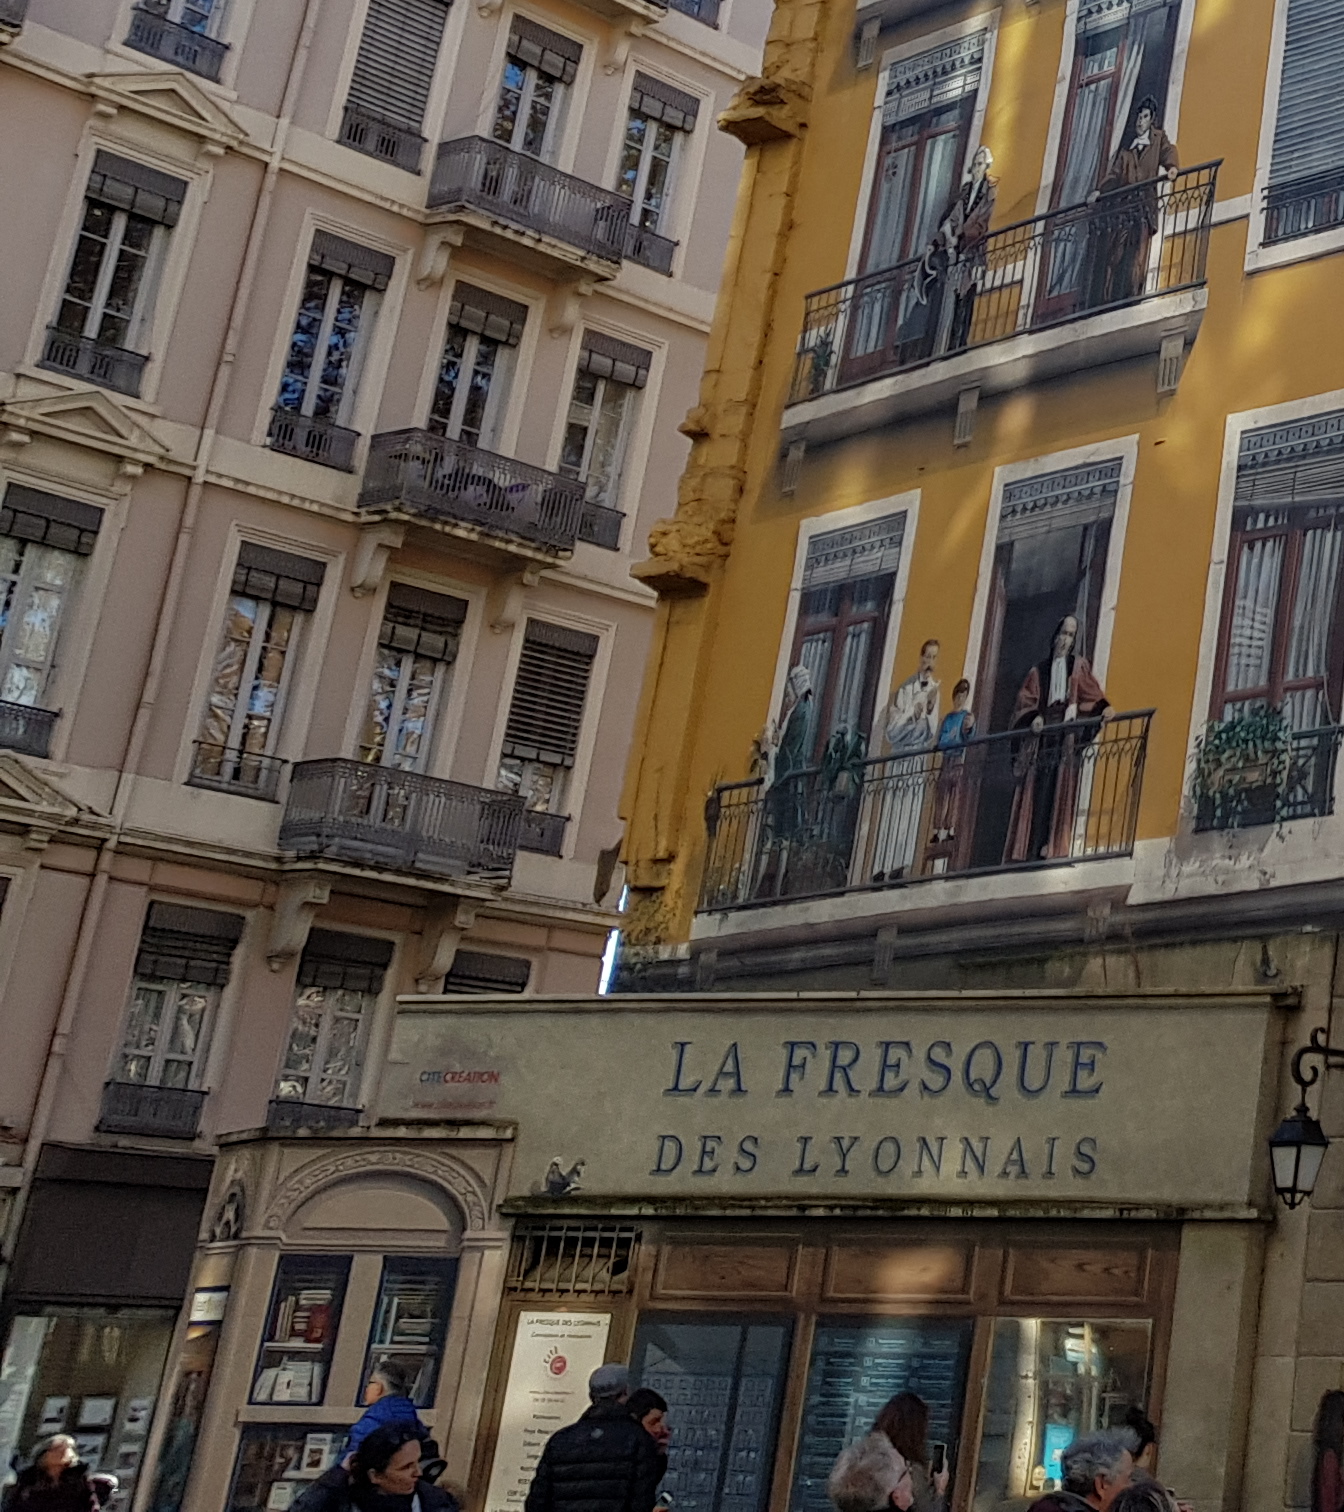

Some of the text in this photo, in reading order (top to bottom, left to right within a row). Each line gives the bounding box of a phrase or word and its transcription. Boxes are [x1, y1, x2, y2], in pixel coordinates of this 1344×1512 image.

[662, 1040, 1108, 1106] LA FRESQUE
[649, 1135, 1098, 1179] DES LYONNAIS
